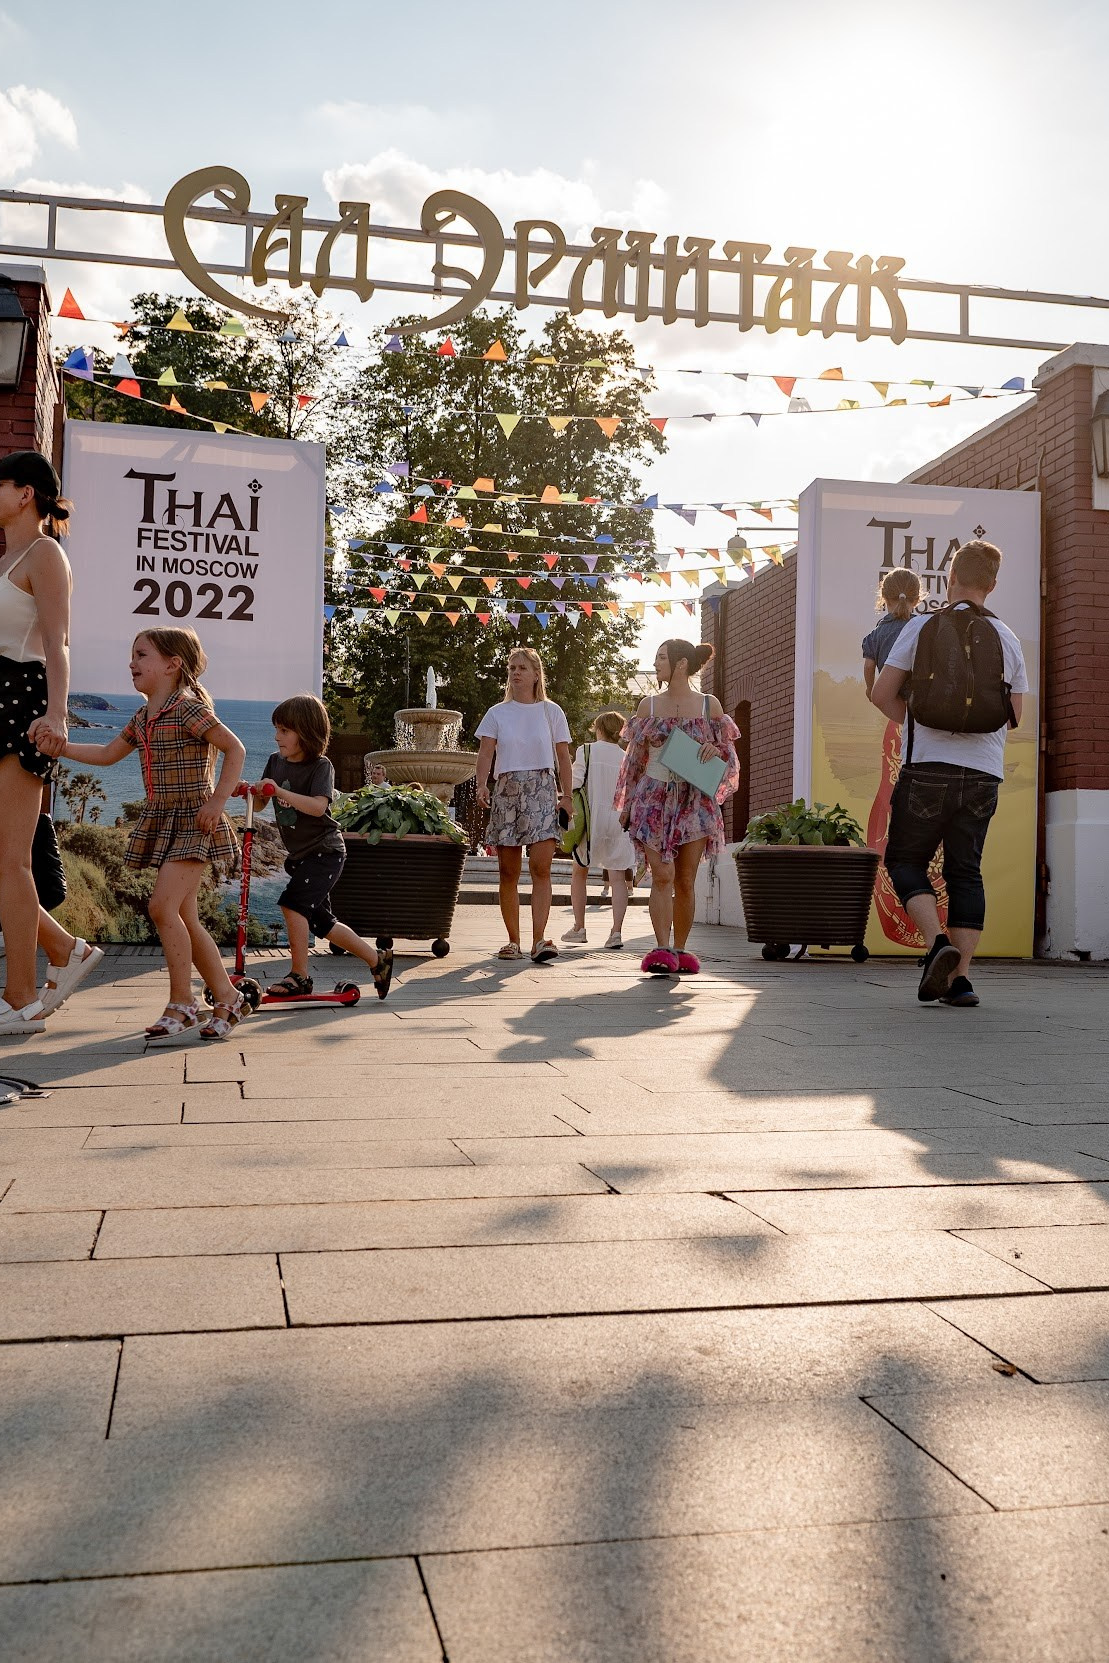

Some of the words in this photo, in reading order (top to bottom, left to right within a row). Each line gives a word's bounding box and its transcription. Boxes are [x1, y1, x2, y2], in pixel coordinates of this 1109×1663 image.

[137, 527, 260, 557] FESTIVAL
[866, 516, 987, 572] THA
[135, 555, 156, 573] IN
[162, 557, 259, 580] MOSCOW
[132, 578, 255, 622] 2022
